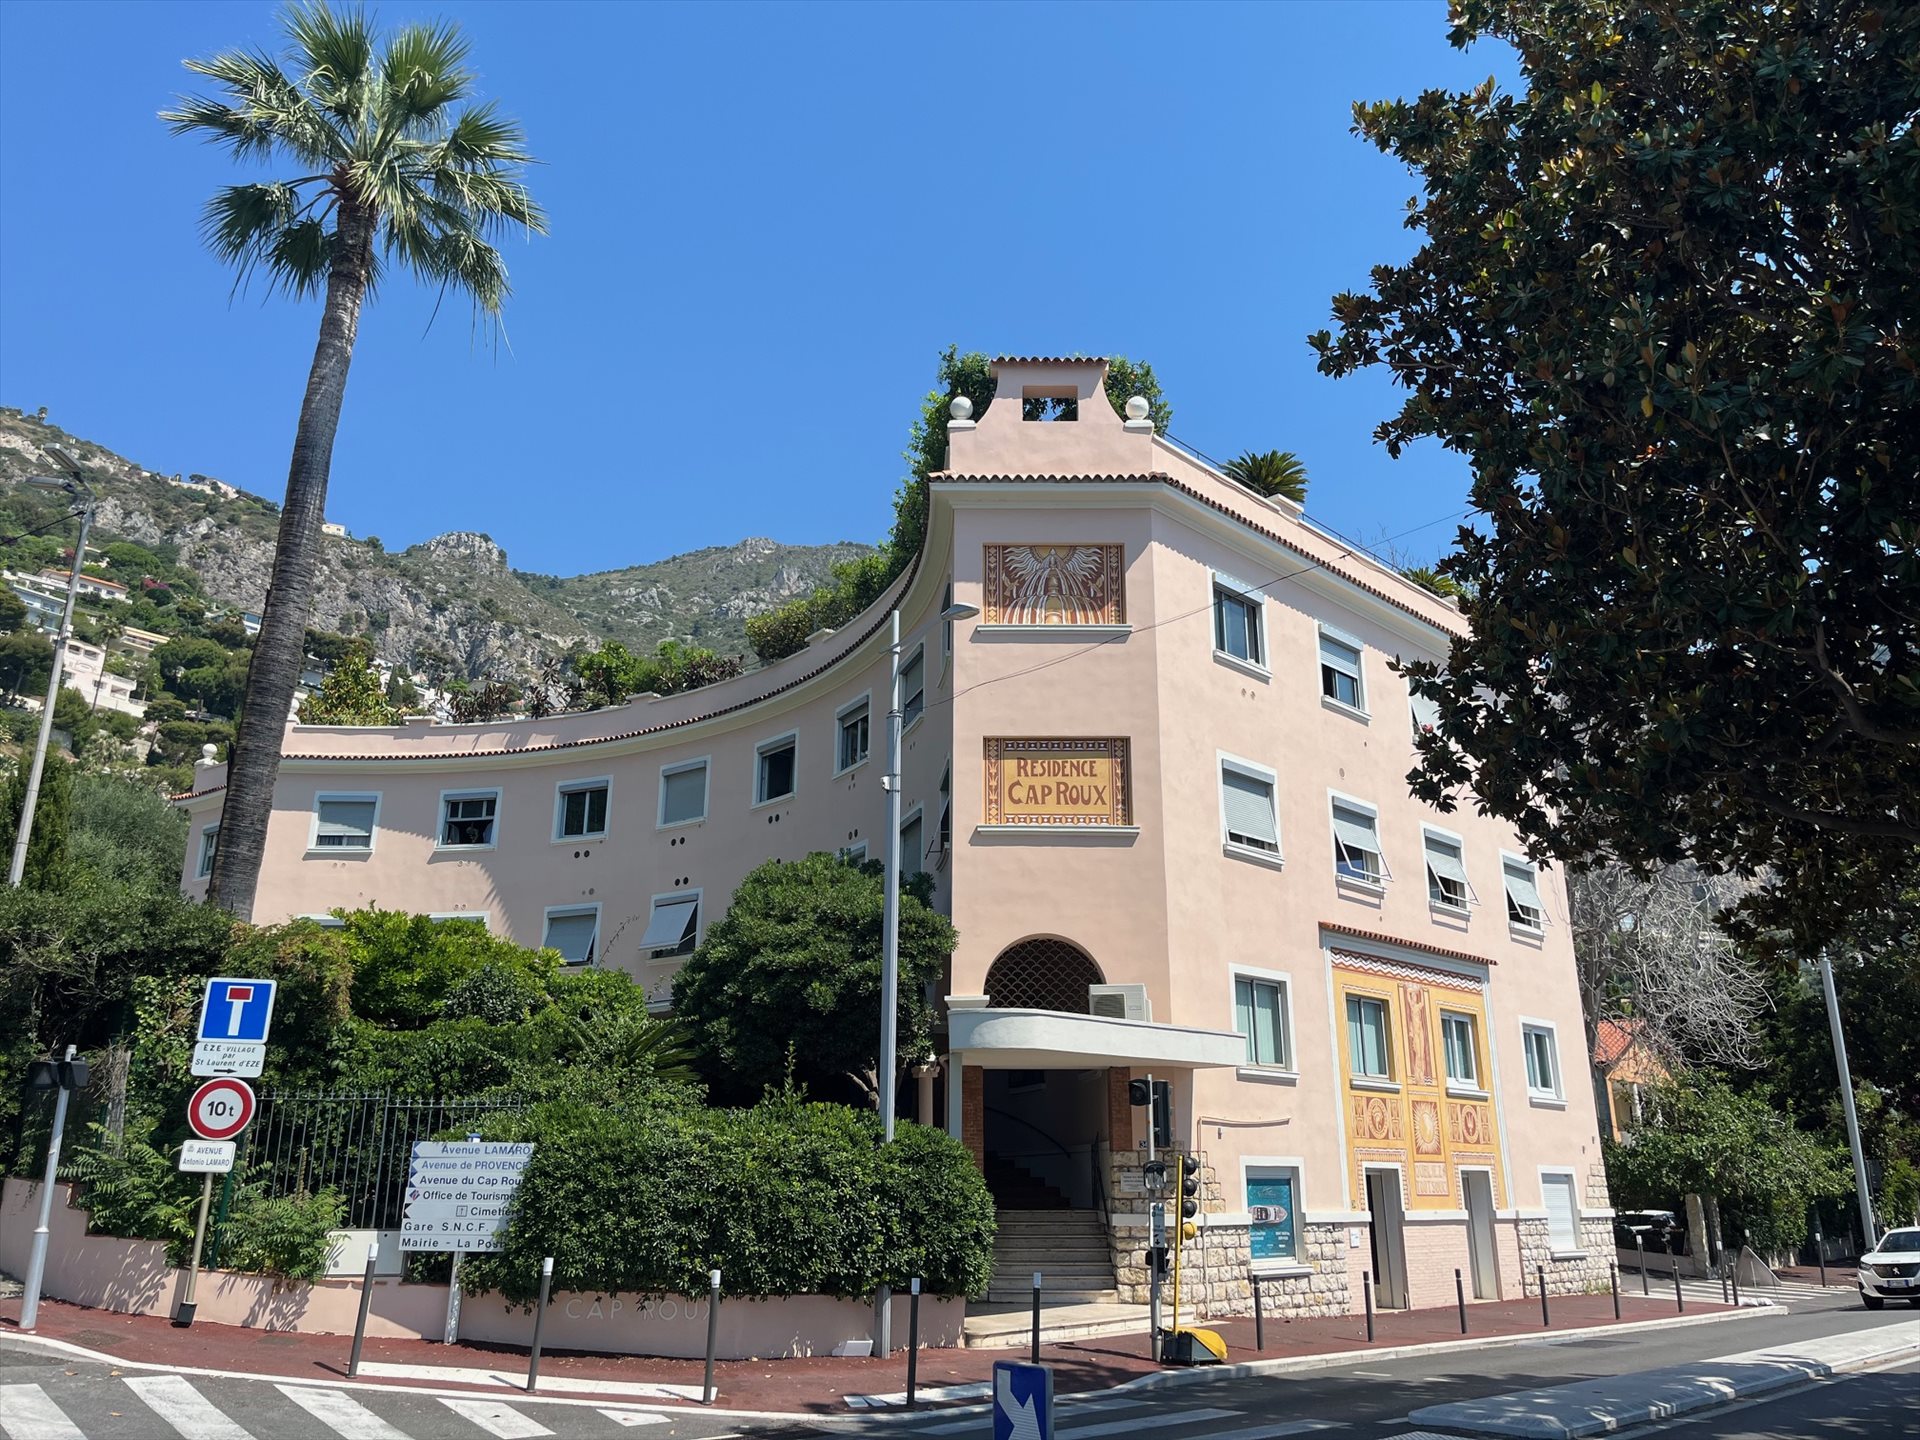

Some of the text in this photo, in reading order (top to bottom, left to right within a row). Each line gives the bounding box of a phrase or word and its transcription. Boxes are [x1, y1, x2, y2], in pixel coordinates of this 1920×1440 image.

[1016, 756, 1098, 777] RESIDENCE
[1007, 779, 1107, 806] CAP ROUX
[194, 1058, 204, 1066] St
[206, 1059, 236, 1067] Laurent
[207, 1101, 235, 1117] 10 t
[196, 1146, 224, 1155] AVENUE
[441, 1145, 531, 1156] Avenue LAMARO
[182, 1158, 205, 1166] Antonio
[421, 1160, 458, 1170] Avenue
[459, 1159, 472, 1170] de
[419, 1175, 526, 1187] Avenue du Cap Rou
[422, 1189, 516, 1201] Office de Tourisme
[404, 1221, 489, 1232] Gare S.N.C.F.
[401, 1237, 439, 1248] Mairie
[457, 1238, 471, 1249] La
[566, 1298, 623, 1320] CAP
